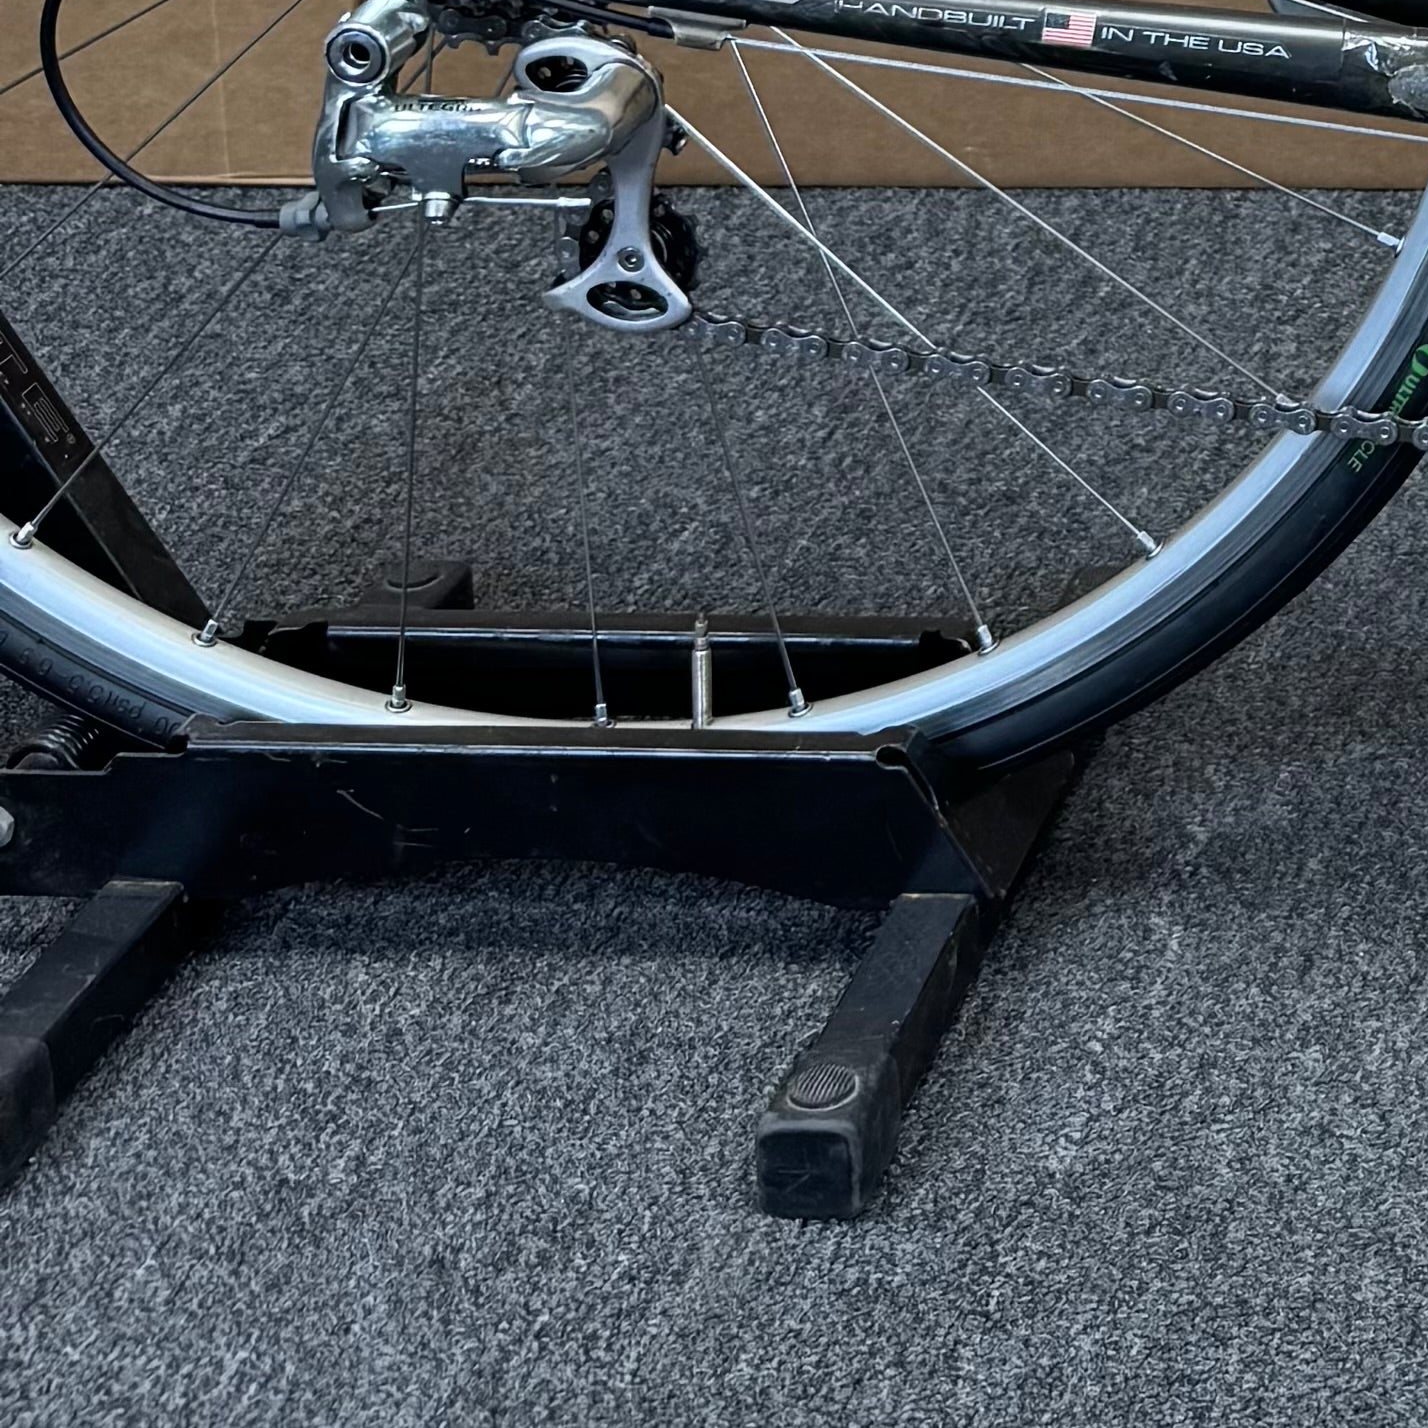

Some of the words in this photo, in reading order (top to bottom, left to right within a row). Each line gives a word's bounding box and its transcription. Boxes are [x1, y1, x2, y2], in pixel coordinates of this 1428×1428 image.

[1101, 25, 1127, 42] IN
[1131, 30, 1208, 50] THE
[1217, 40, 1292, 60] USA
